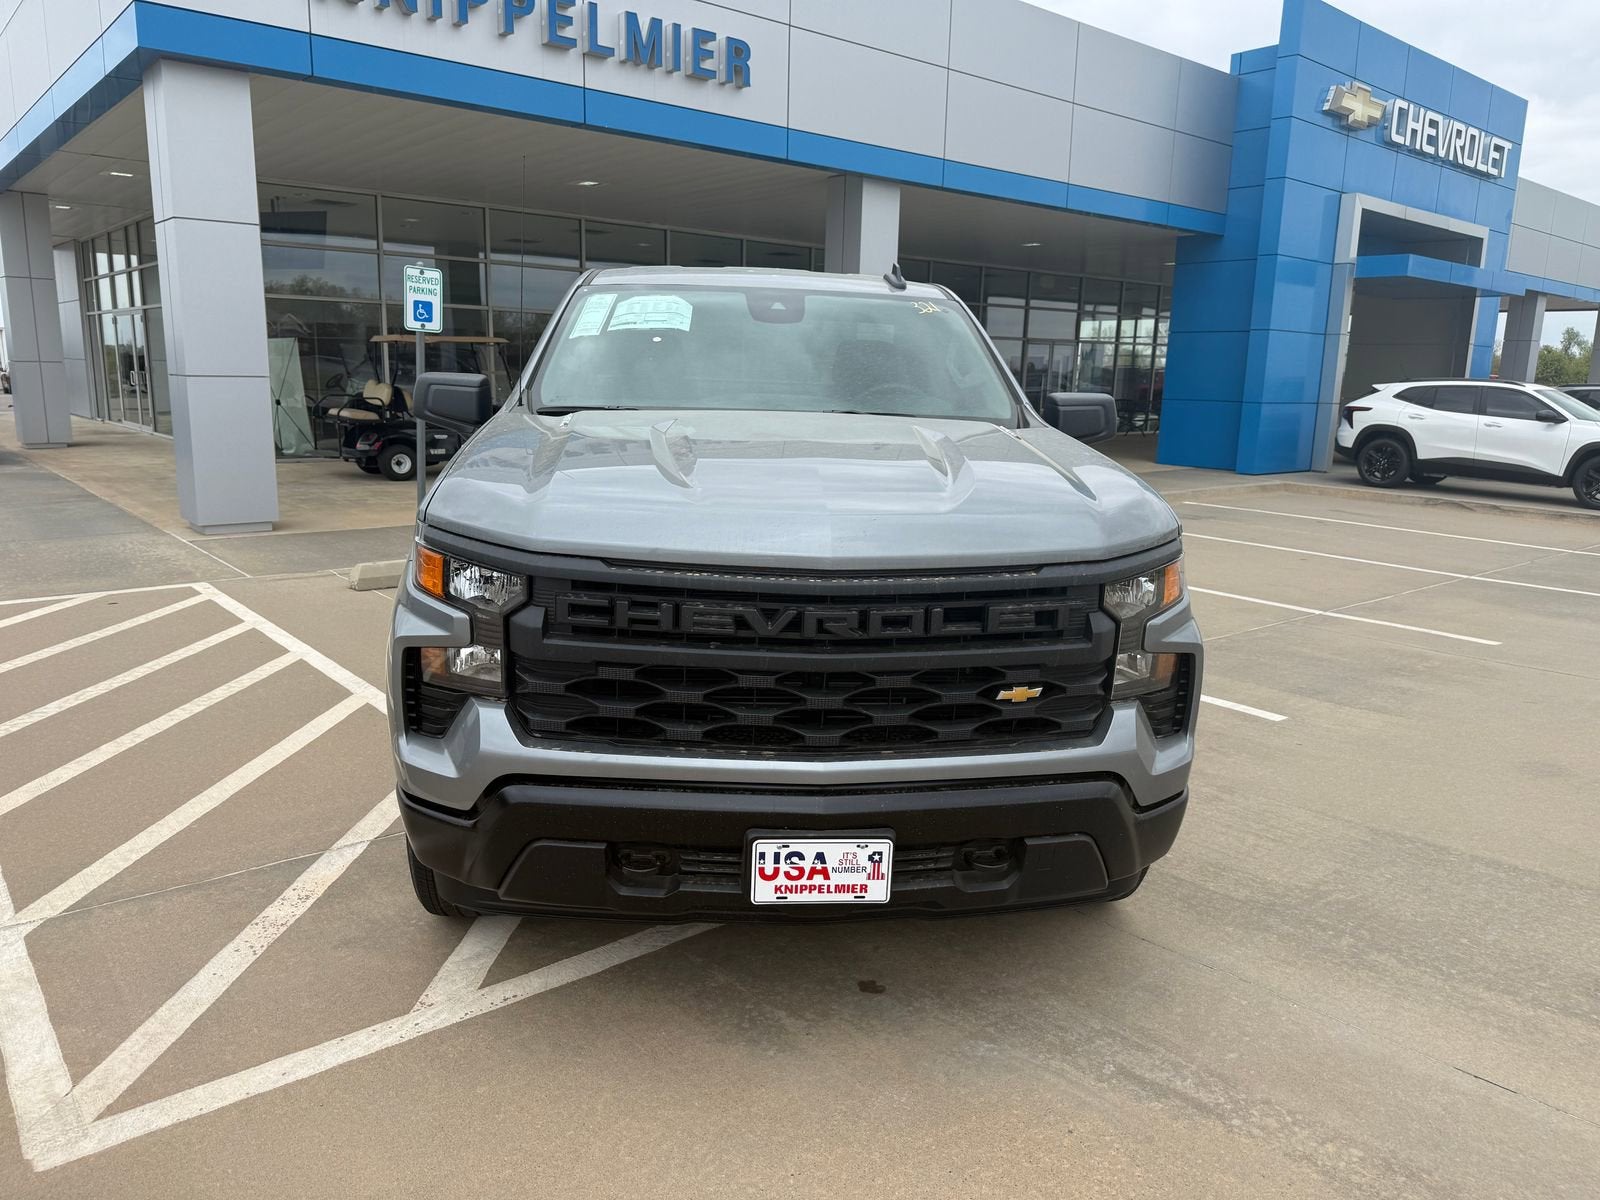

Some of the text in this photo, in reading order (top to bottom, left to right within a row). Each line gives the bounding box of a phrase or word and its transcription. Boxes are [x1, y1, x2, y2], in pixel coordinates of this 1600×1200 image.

[1389, 98, 1512, 178] CHEVROLET
[407, 274, 439, 285] RESERVED
[408, 285, 438, 296] PARKING
[554, 594, 1085, 638] CHEVROLET
[842, 851, 858, 860] IT'S
[758, 851, 831, 881] USA
[831, 866, 867, 874] NUMBER
[774, 883, 868, 895] KNIPPELMIER
